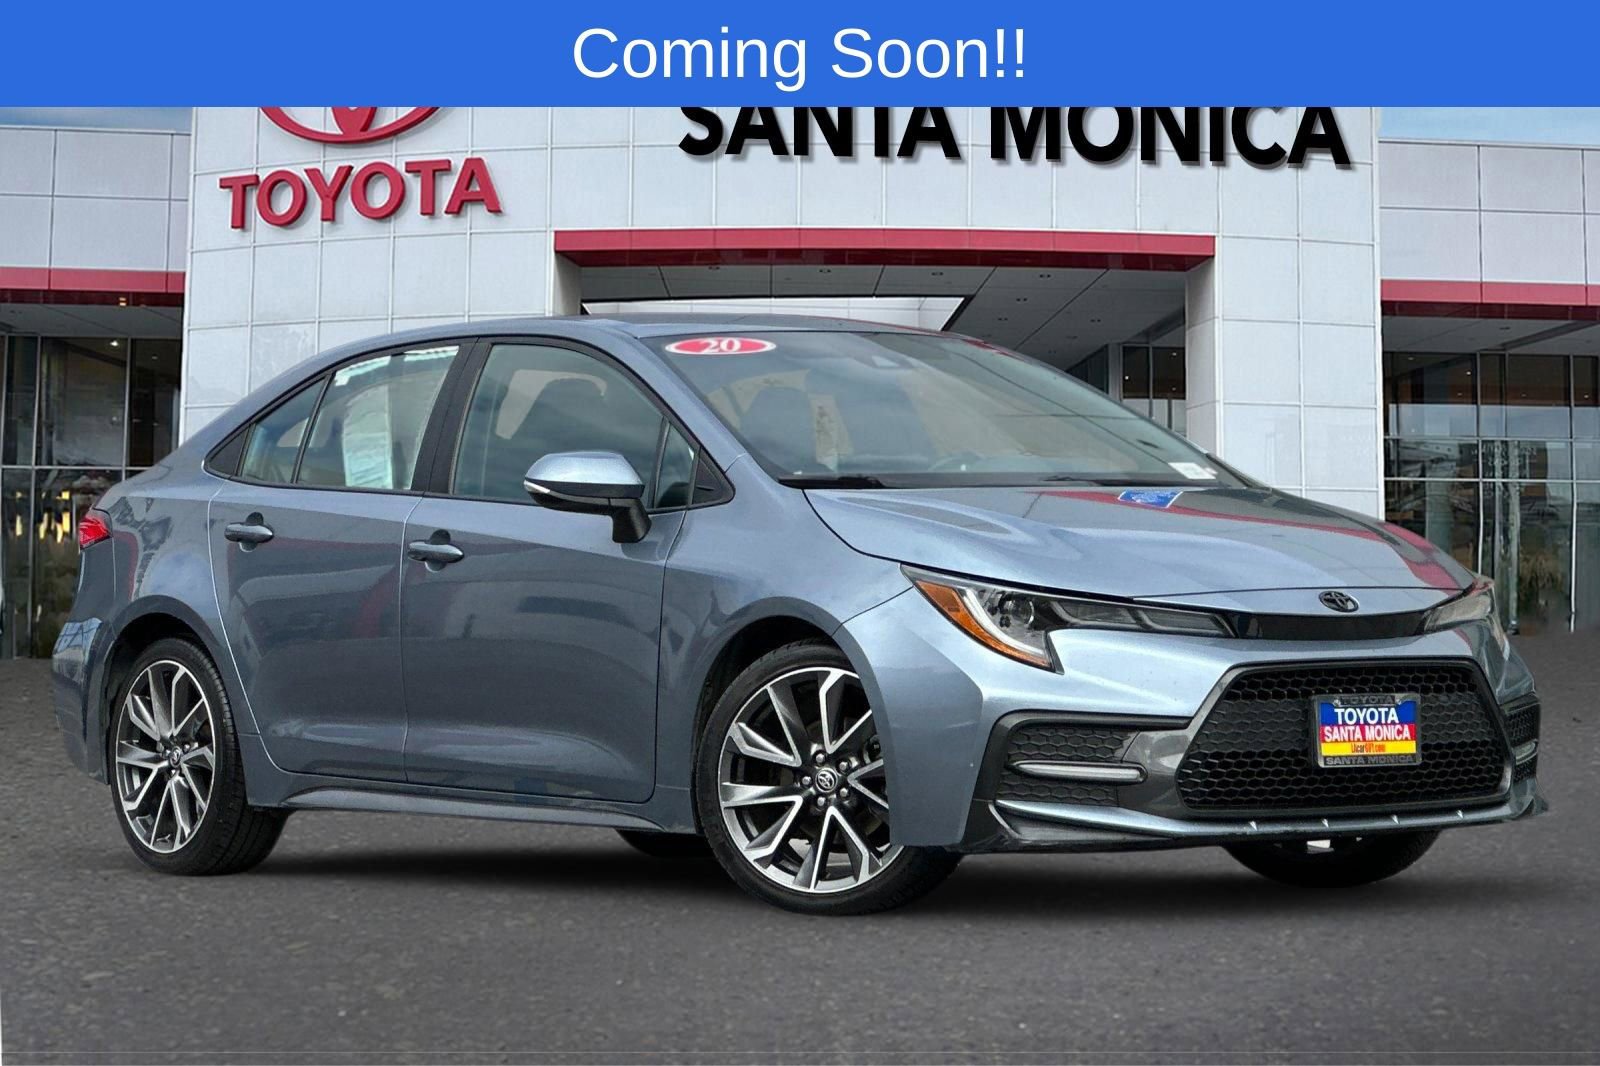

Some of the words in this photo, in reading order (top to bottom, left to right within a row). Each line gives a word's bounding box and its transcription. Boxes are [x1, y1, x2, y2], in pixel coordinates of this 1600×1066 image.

[990, 107, 1352, 169] MONICA
[219, 157, 503, 229] TOYOTA
[698, 337, 741, 353] 20
[1334, 707, 1399, 725] TOYOTA
[1324, 725, 1363, 742] SANTA
[1365, 724, 1411, 741] MONICA
[1326, 757, 1364, 765] SANTA
[1367, 755, 1414, 764] MONICA
